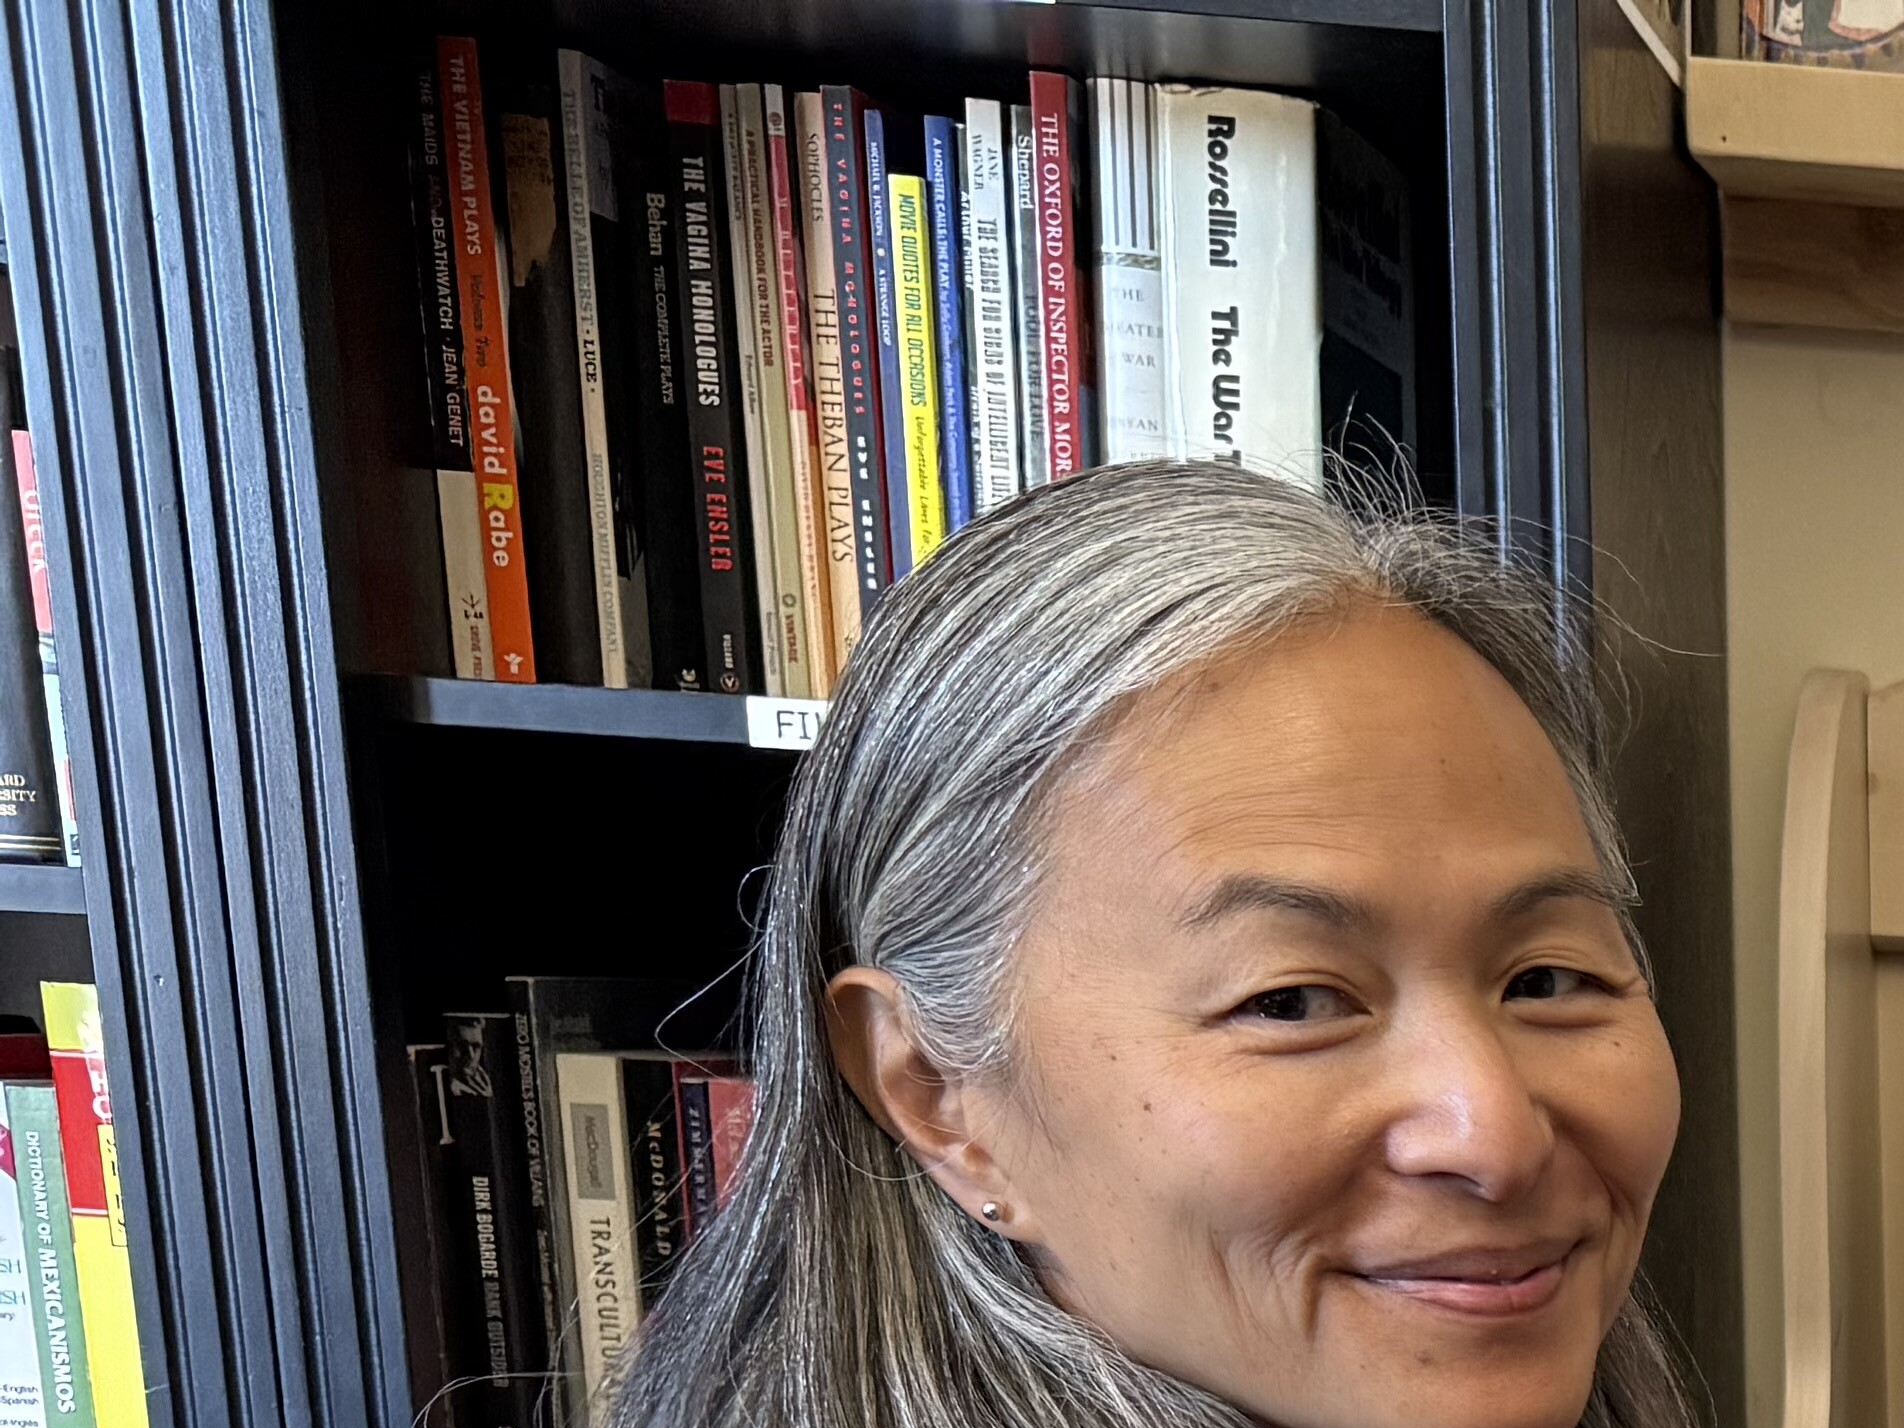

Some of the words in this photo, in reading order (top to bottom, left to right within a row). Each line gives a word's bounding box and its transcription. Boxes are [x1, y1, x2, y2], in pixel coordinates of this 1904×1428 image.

[450, 56, 464, 88] THE
[454, 93, 473, 192] VIETNAM
[682, 157, 704, 192] THE
[807, 133, 823, 222] SOPHOCLES
[1017, 133, 1034, 206] Shepard
[462, 197, 481, 255] PLAYS
[647, 193, 664, 255] Behan
[1205, 114, 1239, 269] Rossellini
[684, 202, 710, 270] VAGINA
[691, 280, 721, 406] MONOLOGUES
[1211, 305, 1239, 368] The
[477, 385, 507, 475] david
[1209, 375, 1241, 445] War
[703, 446, 724, 483] EVE
[483, 483, 514, 567] Rabe
[706, 493, 733, 570] ENSLER
[25, 1130, 50, 1219] DICTIONARY
[35, 1221, 52, 1245] OF
[36, 1246, 77, 1414] MEXICANISMOS
